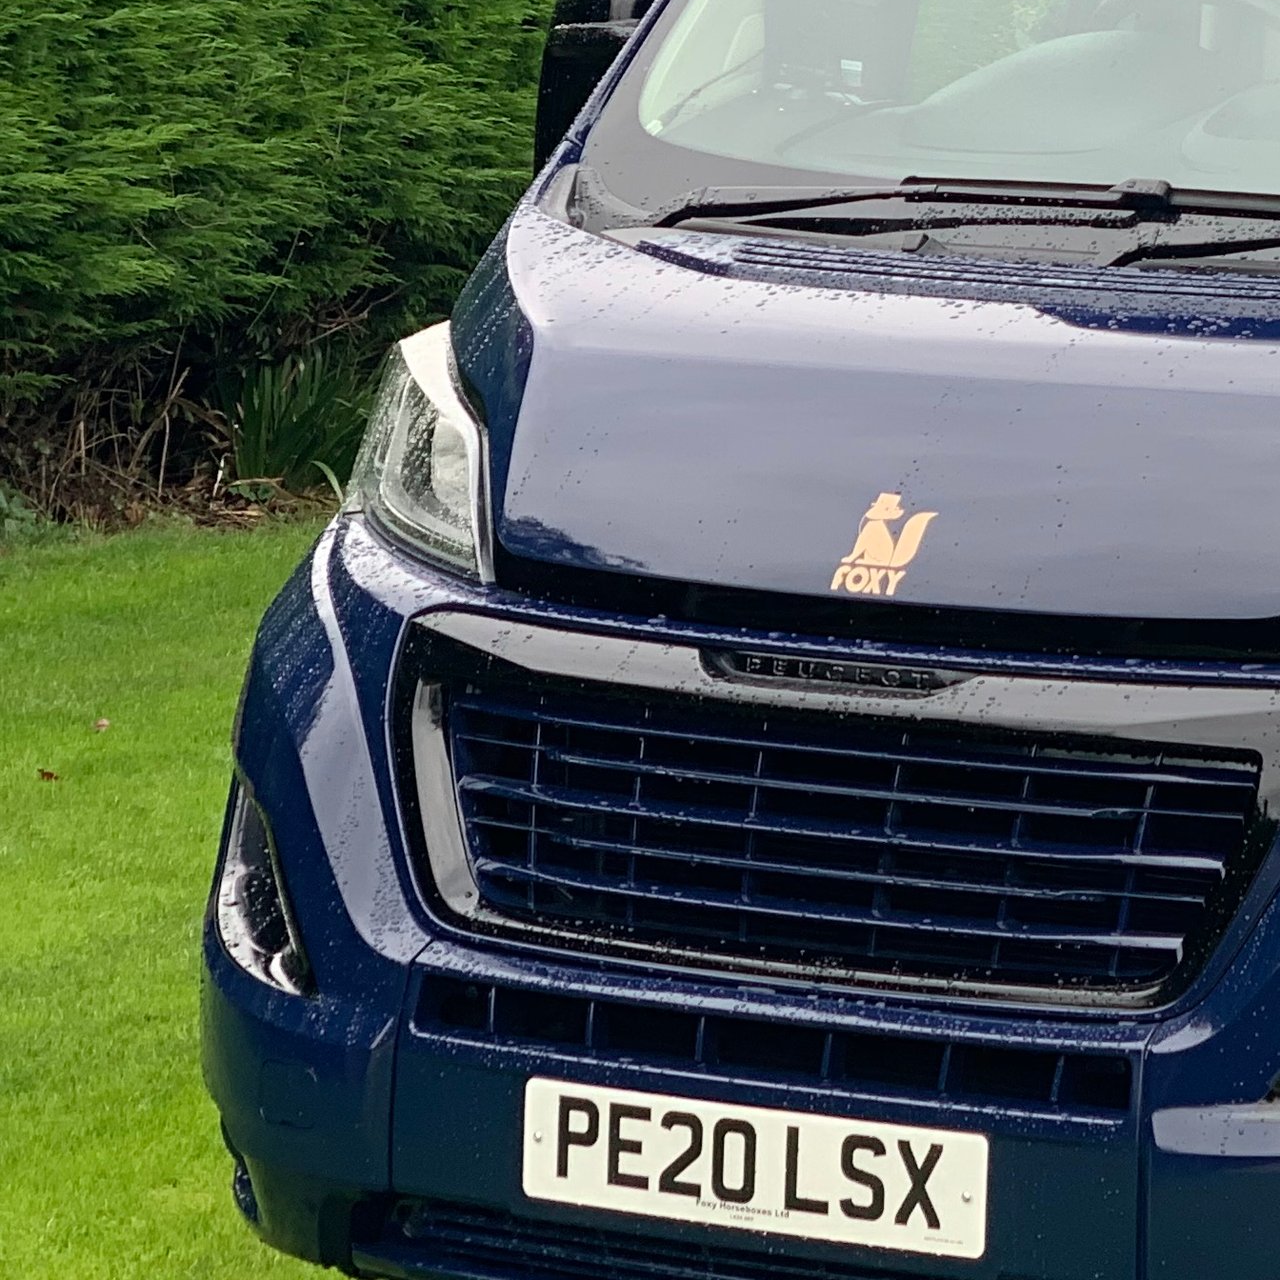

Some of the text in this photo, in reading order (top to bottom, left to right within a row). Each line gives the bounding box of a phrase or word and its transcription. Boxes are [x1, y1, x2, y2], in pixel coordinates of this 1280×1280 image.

[830, 565, 907, 596] FOXY
[746, 656, 929, 688] PEUGEOT
[556, 1094, 944, 1231] PE20 LSX
[720, 1202, 772, 1216] Horseboxes
[775, 1209, 790, 1218] Ltd
